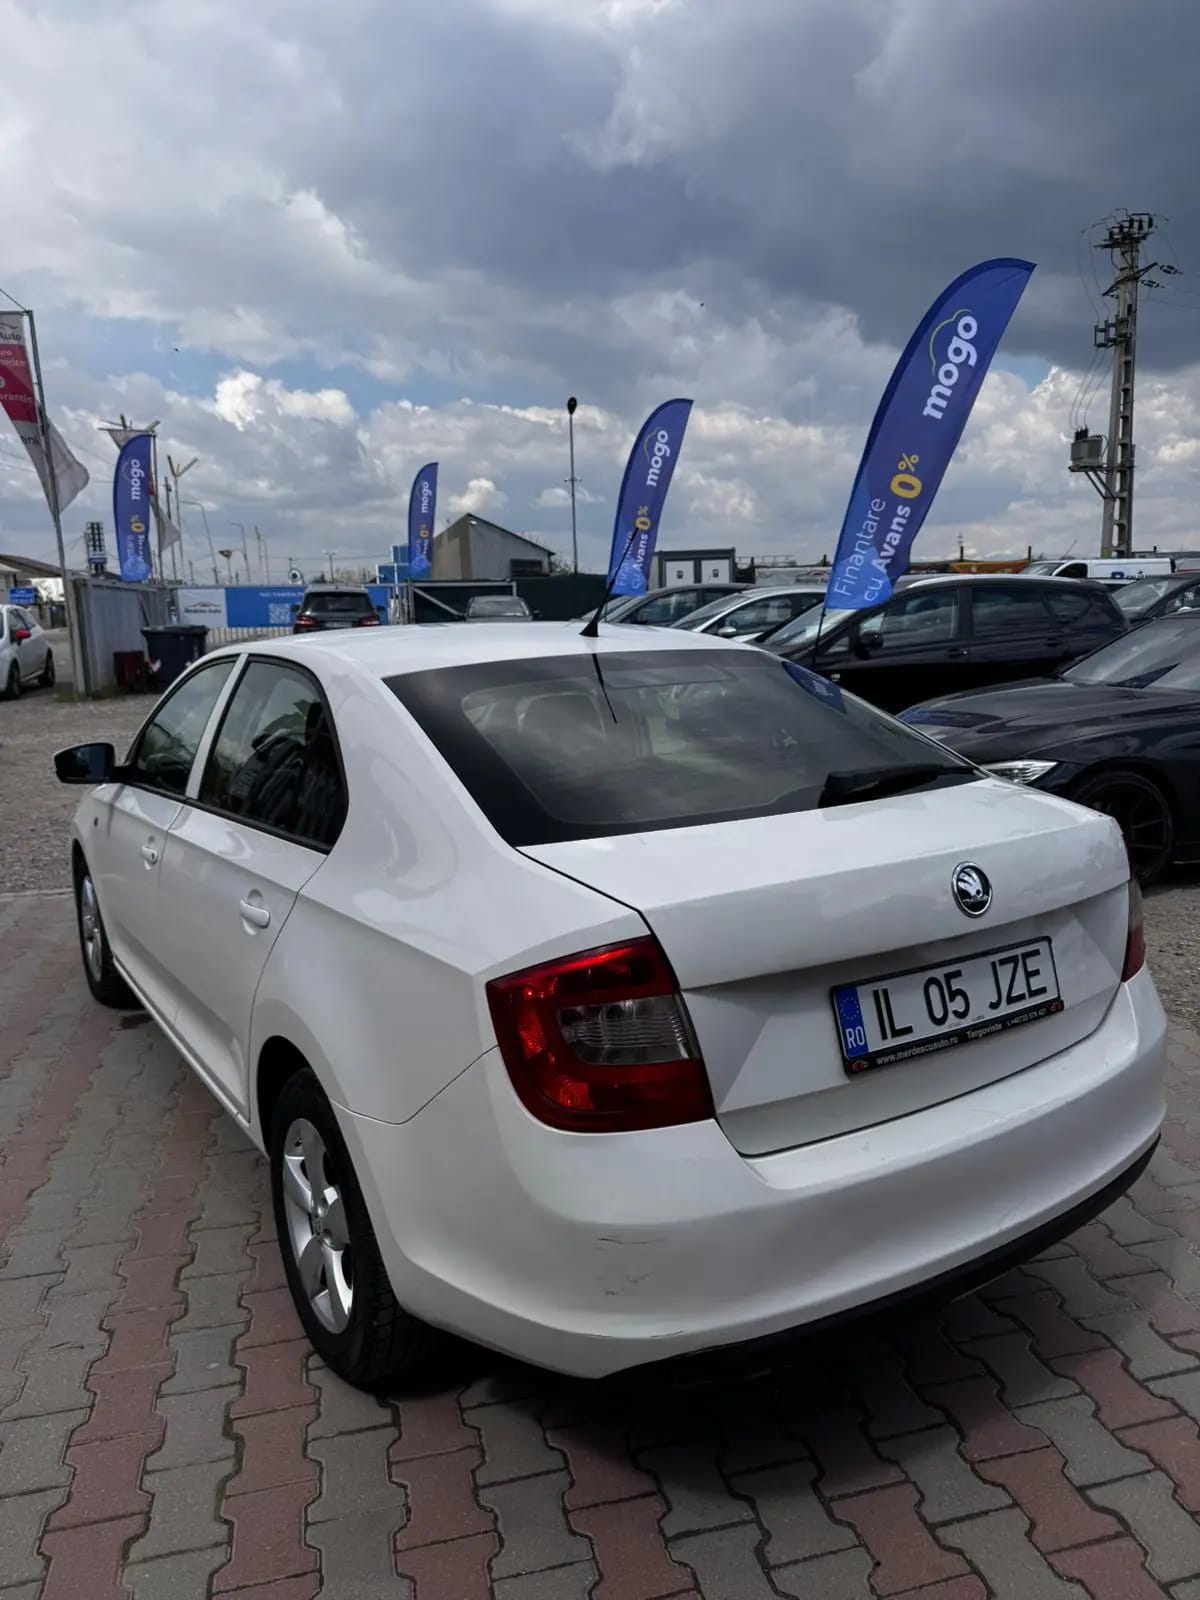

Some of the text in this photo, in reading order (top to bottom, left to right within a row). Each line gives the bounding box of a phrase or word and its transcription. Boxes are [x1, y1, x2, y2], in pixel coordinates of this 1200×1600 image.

[922, 315, 978, 420] mogo
[130, 459, 145, 500] mogo
[646, 429, 670, 487] mogo
[421, 481, 432, 513] mogo
[632, 533, 649, 572] Avans
[834, 497, 886, 597] Finantare
[864, 453, 923, 602] cu Avans 0%
[873, 948, 1047, 1040] IL 05 JZE
[845, 1026, 866, 1050] RO
